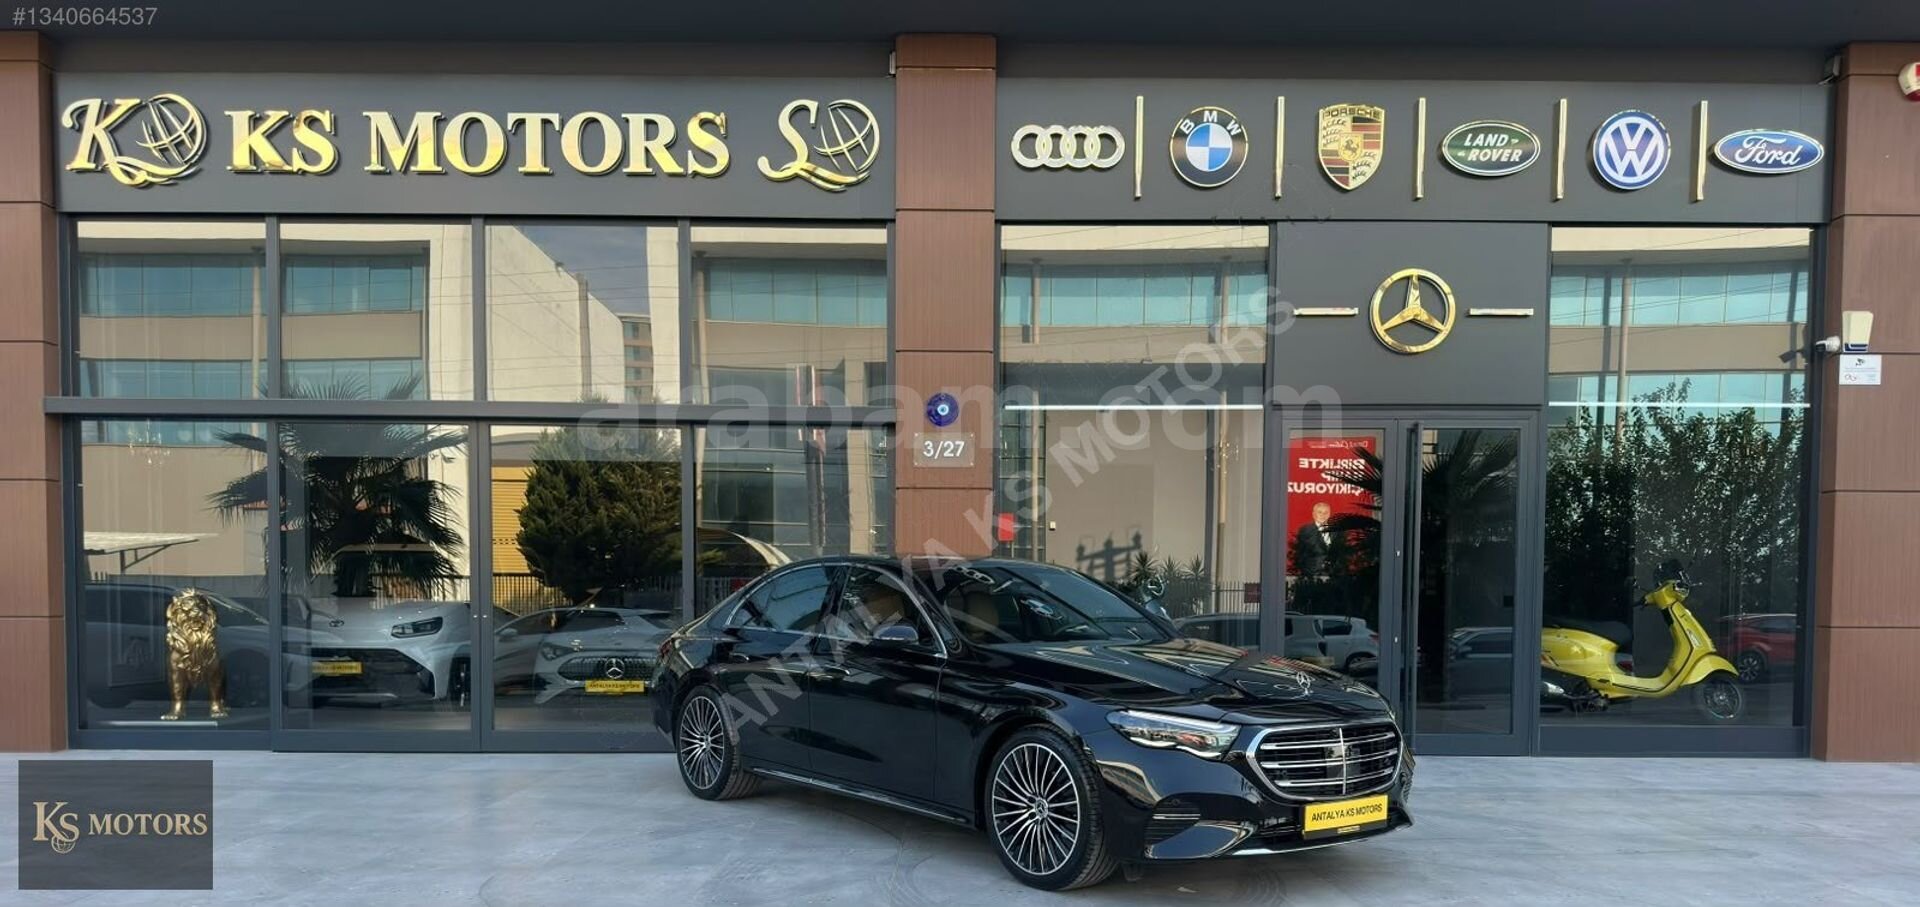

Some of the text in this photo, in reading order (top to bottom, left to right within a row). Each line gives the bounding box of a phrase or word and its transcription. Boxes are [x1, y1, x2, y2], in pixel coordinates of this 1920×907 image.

[1323, 107, 1382, 119] PORSCHE
[1180, 110, 1242, 136] BMW
[224, 109, 732, 178] KS MOTORS
[1463, 133, 1510, 147] LAND
[1467, 148, 1523, 162] ROVER
[1734, 135, 1804, 166] Ford
[922, 440, 965, 460] 3/27
[1311, 803, 1383, 821] ANTALYA KS MOTORS
